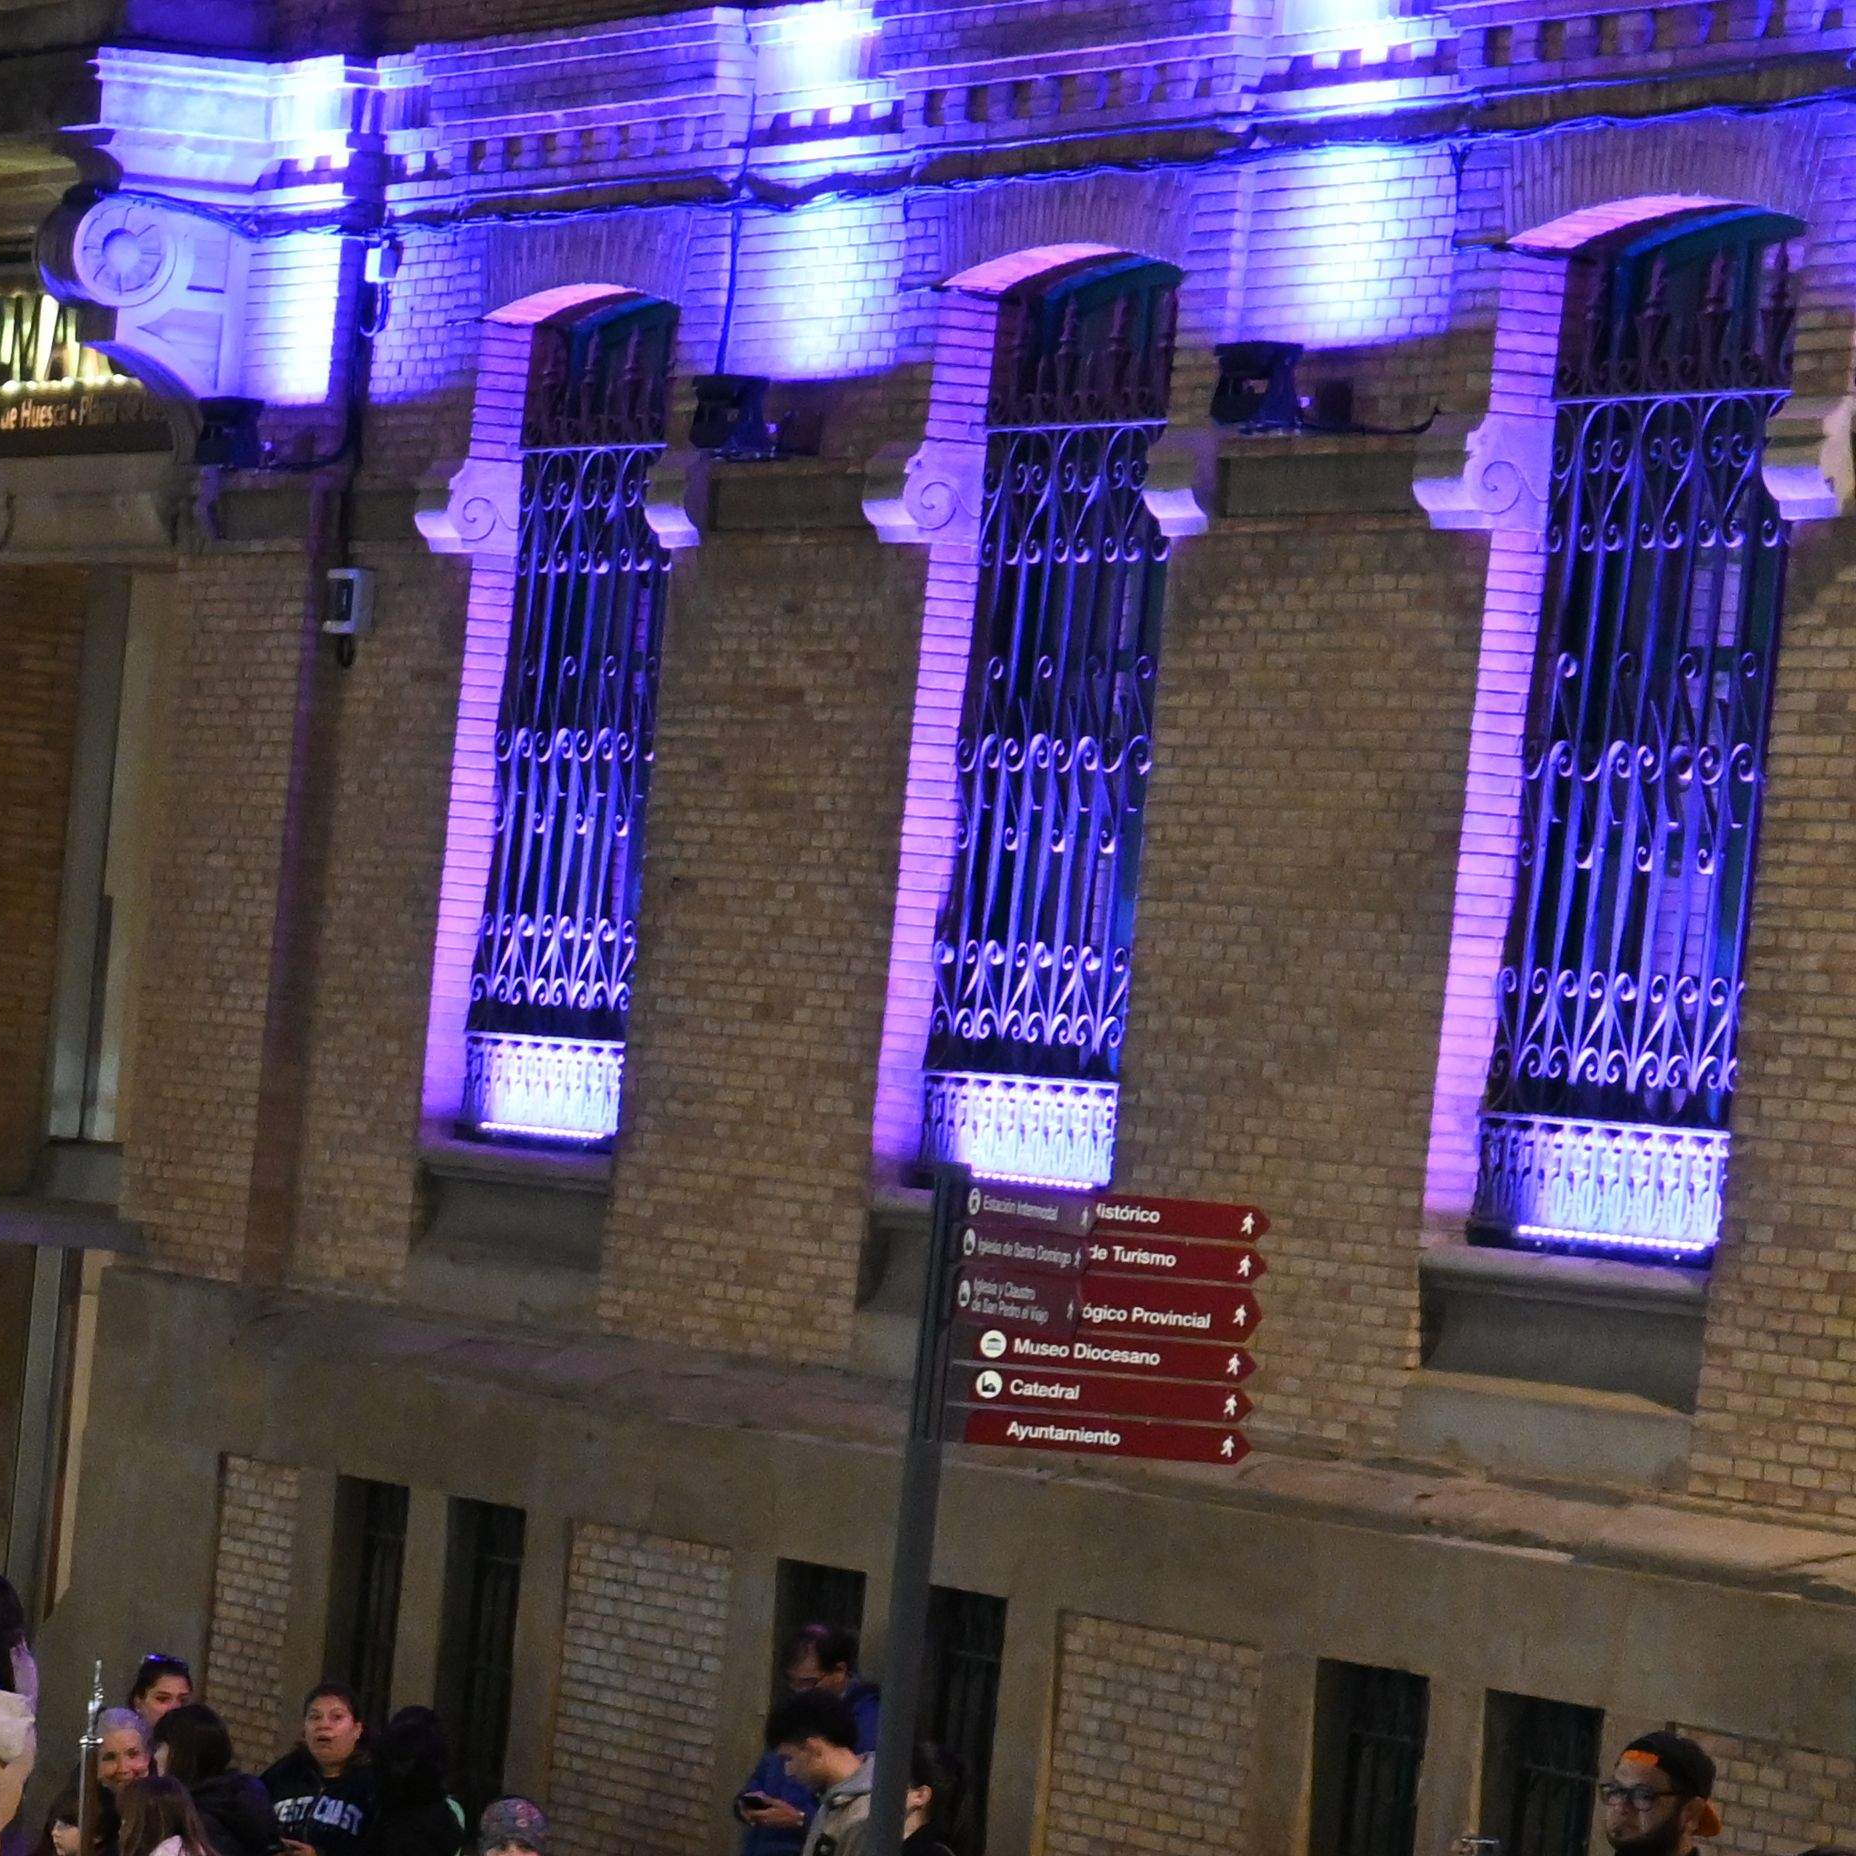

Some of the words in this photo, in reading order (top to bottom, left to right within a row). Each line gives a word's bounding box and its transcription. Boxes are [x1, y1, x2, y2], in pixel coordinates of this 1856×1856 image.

[1112, 1245, 1177, 1268] Turismo
[1131, 1306, 1212, 1330] Provincial
[1012, 1337, 1071, 1359] Museo
[1073, 1342, 1161, 1366] Diocesano
[1009, 1378, 1081, 1401] Catedral
[1006, 1420, 1122, 1447] Ayuntamiento
